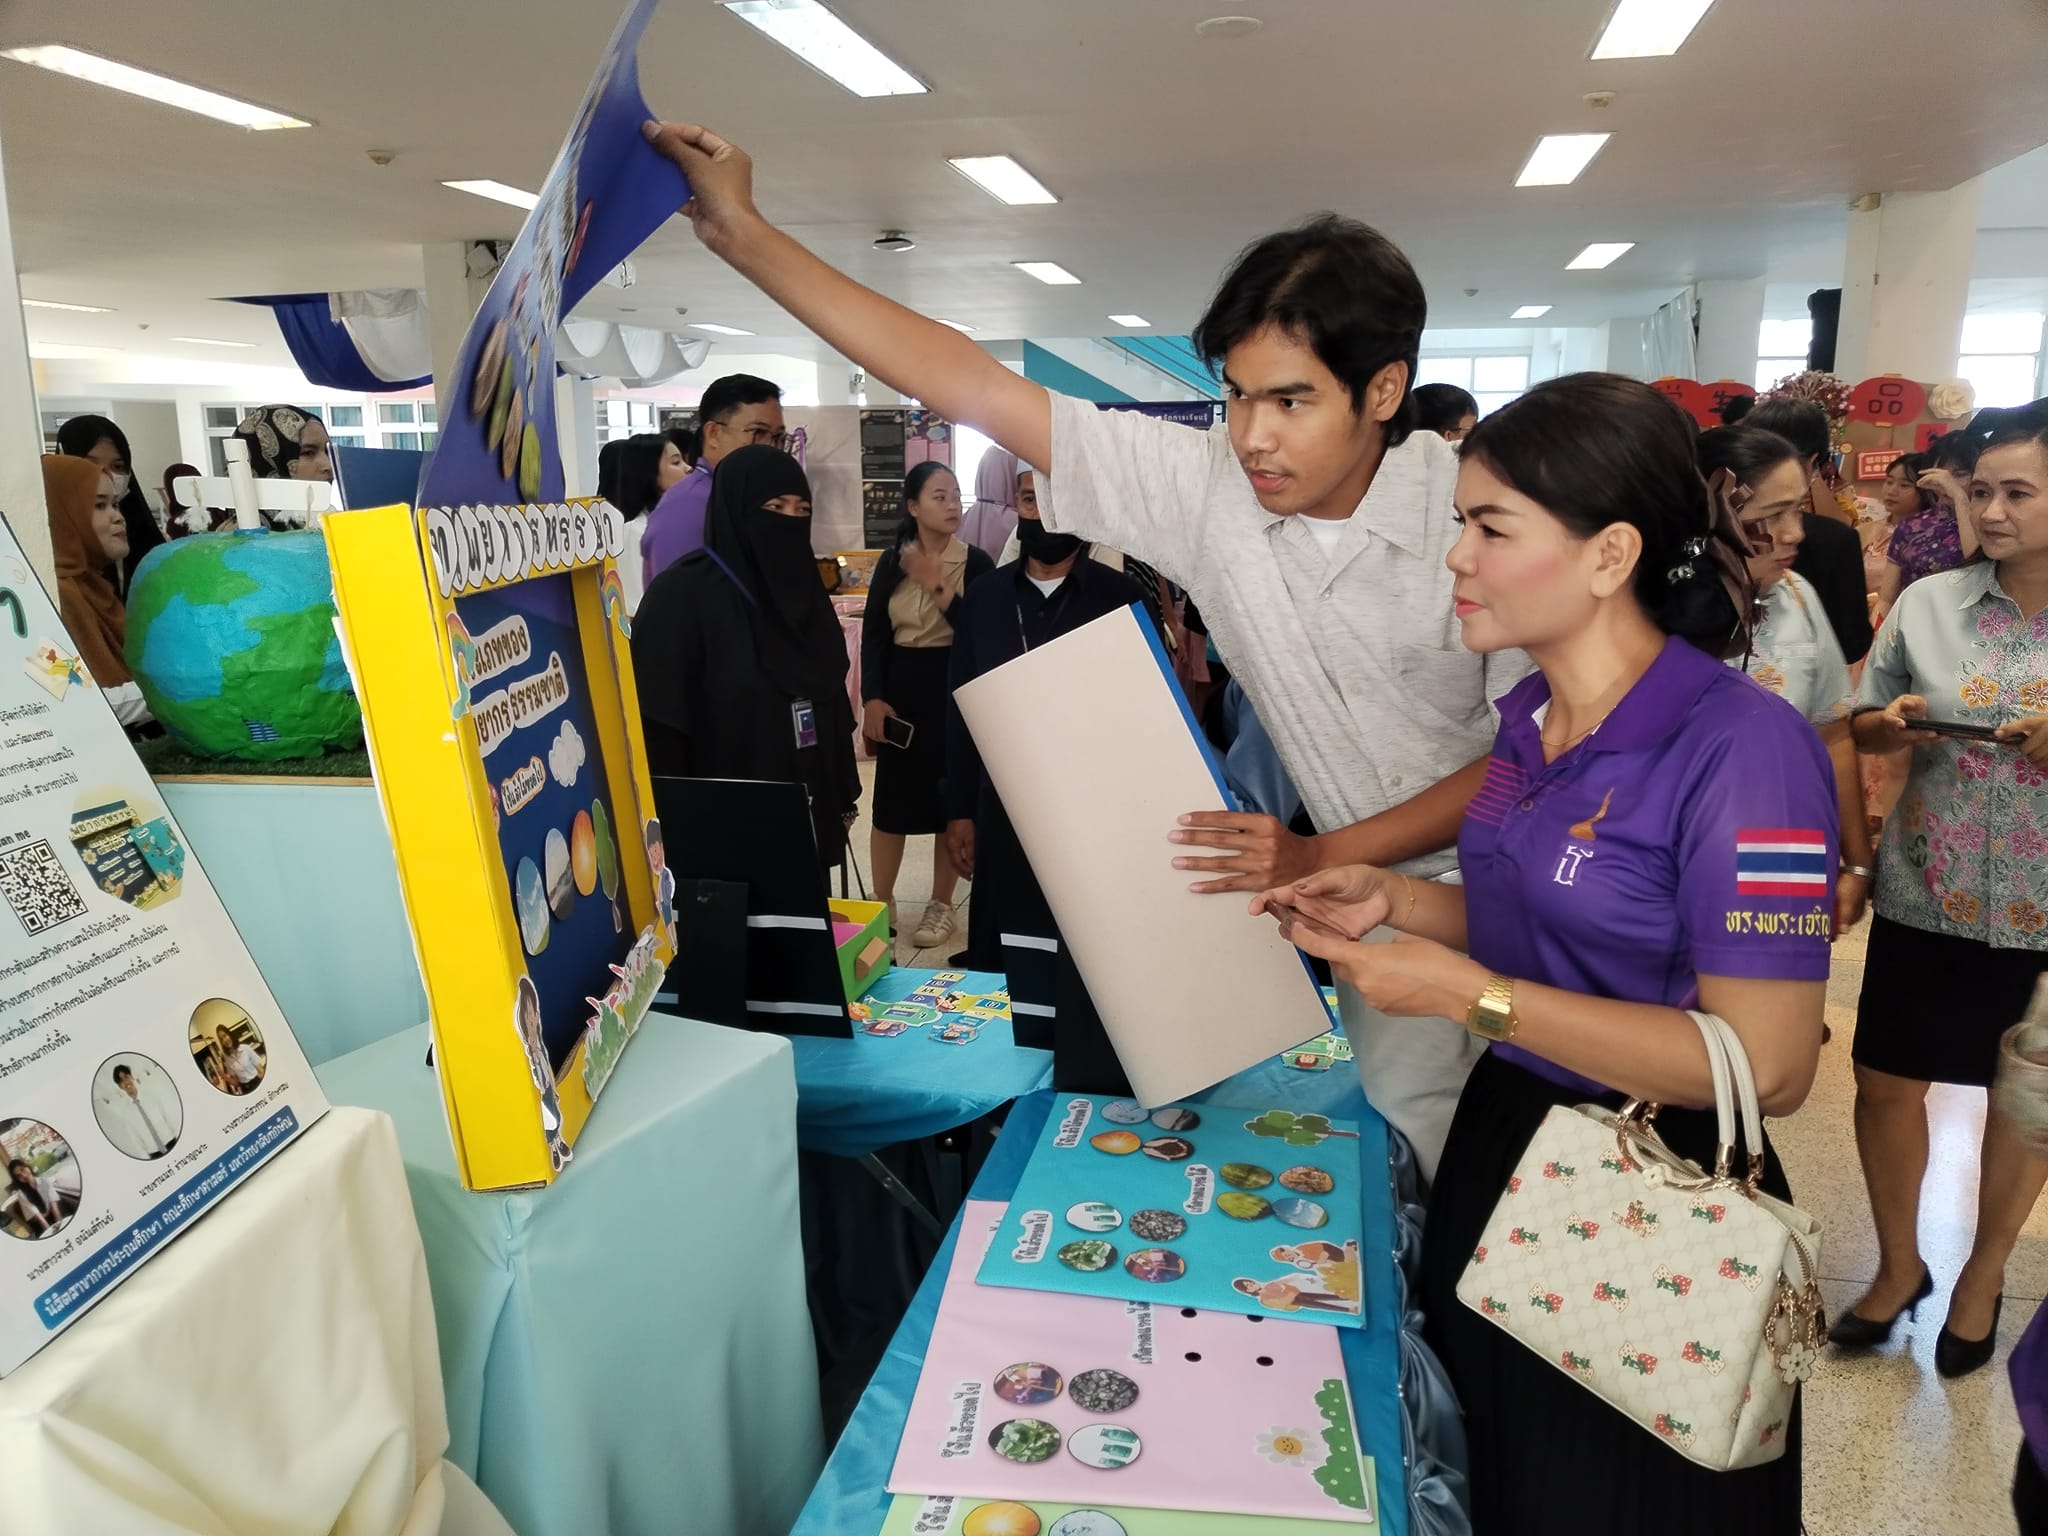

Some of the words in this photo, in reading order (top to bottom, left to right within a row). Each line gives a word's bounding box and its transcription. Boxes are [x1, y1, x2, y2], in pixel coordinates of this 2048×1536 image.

[430, 508, 614, 582] ทพยากรหรรษา
[473, 656, 566, 746] ยากรธรรมชาติ
[15, 829, 31, 842] me
[1725, 905, 1831, 942] ทรงพระเจริญ
[44, 1221, 163, 1318] นิสิตสาขาการประถมศึกษา
[161, 1166, 229, 1226] คณะศึกษาศาสตร์
[228, 1115, 294, 1173] มหาวิทยาลัยทักษิณ
